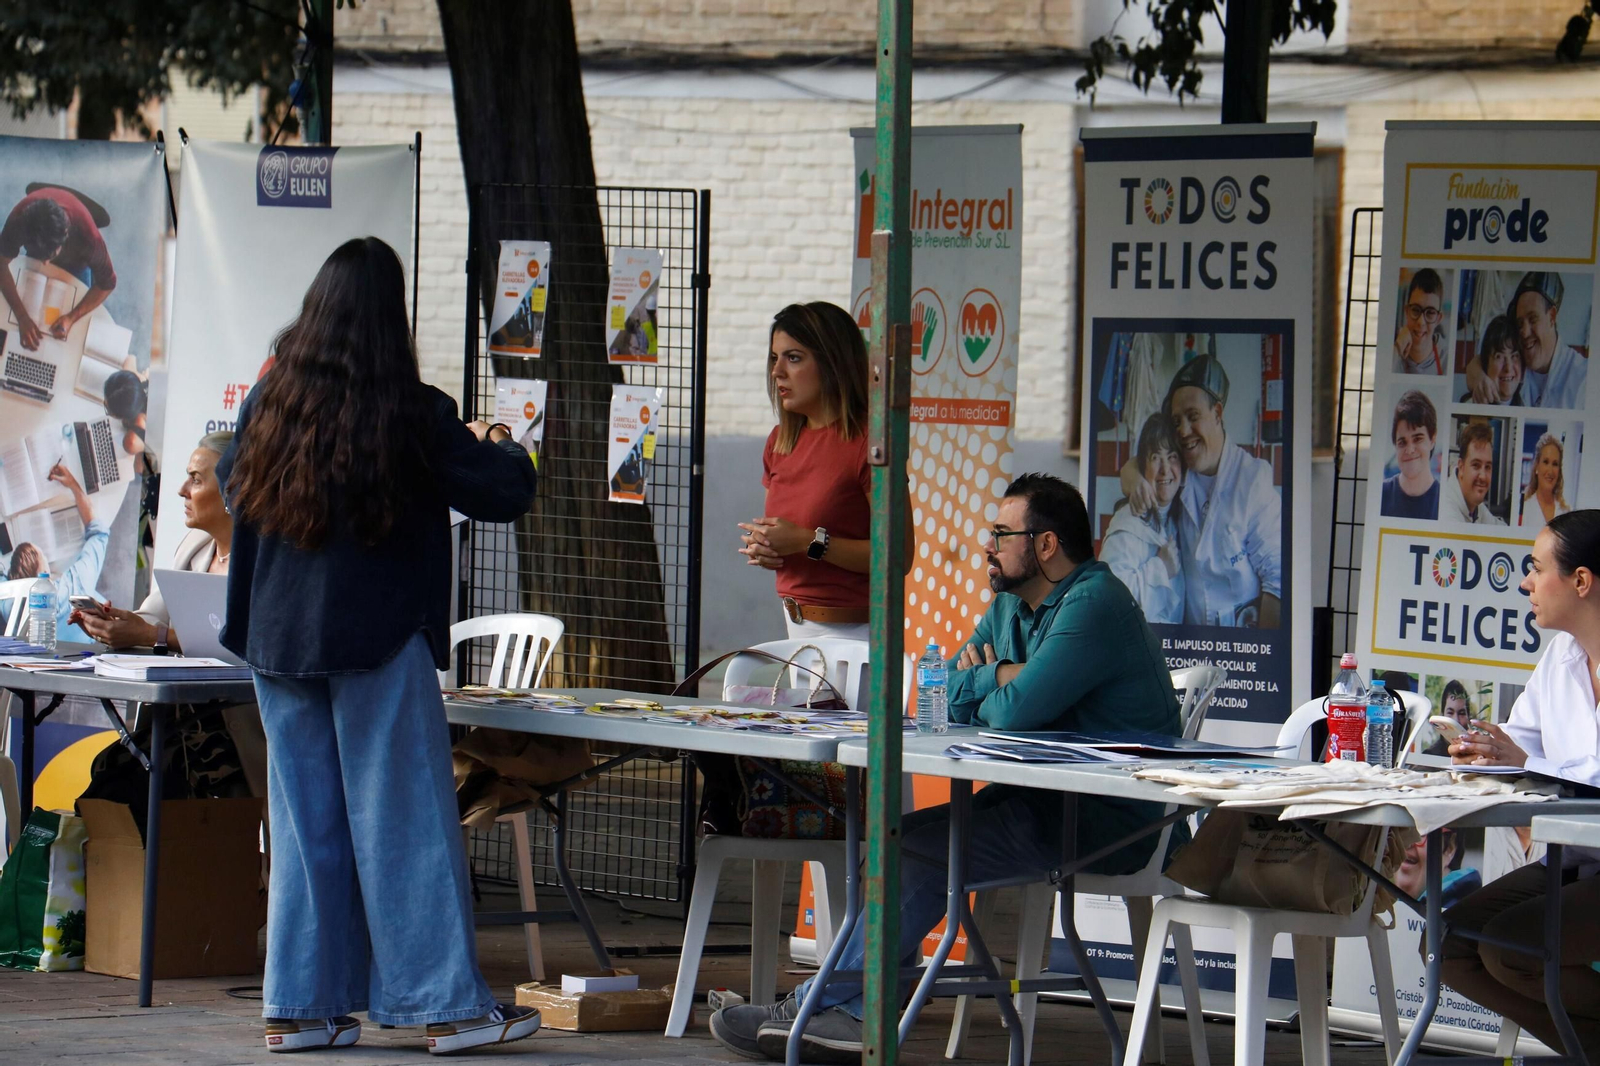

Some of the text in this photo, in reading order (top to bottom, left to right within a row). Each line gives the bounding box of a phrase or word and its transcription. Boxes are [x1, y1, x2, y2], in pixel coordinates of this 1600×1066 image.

[290, 156, 328, 175] GRUPO
[290, 177, 327, 196] EULEN
[1447, 172, 1521, 200] Fundación
[1120, 174, 1271, 225] TODOS
[910, 187, 1013, 237] Integral
[1443, 197, 1549, 250] prode
[975, 231, 992, 249] Sur
[1110, 240, 1278, 290] FELICES
[940, 407, 947, 419] a
[1399, 598, 1541, 653] FELICES
[1162, 639, 1271, 655] EL IMPULSO DEL TEJIDO DE
[1216, 659, 1245, 672] SOCIAL
[1247, 661, 1257, 672] DE
[1255, 681, 1266, 691] DE
[1268, 681, 1279, 692] LA
[1086, 948, 1097, 957] OT
[1105, 950, 1134, 960] Promove
[1217, 960, 1236, 969] inclus
[1395, 989, 1425, 1003] Cristób
[1446, 998, 1492, 1016] Pozoblanco
[1467, 1016, 1501, 1034] (Córdob
